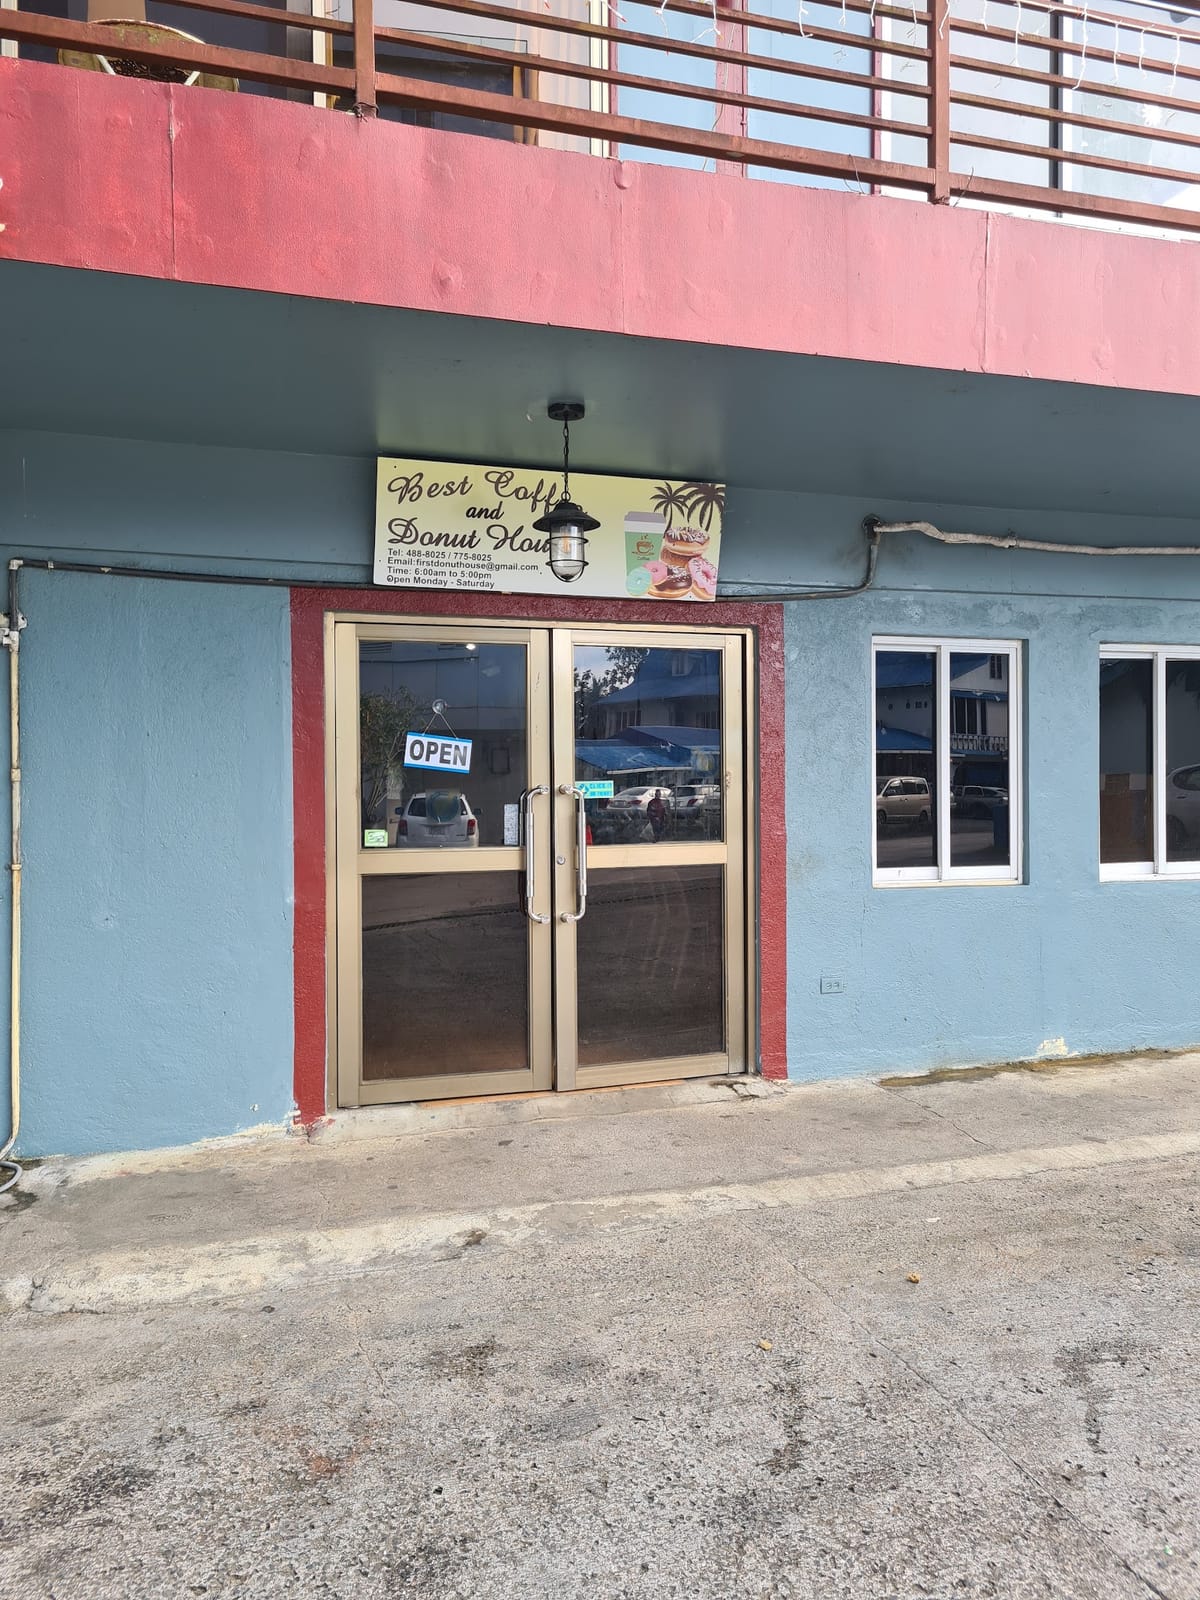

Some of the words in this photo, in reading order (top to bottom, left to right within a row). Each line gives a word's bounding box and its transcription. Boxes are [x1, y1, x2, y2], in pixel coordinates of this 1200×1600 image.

[387, 472, 473, 504] Best
[484, 470, 588, 516] Coff
[465, 501, 504, 520] and
[387, 517, 481, 549] Donut
[486, 524, 571, 553] Hou
[387, 548, 404, 557] Tel:
[406, 549, 446, 559] 488-8025
[453, 552, 492, 562] 775-8025
[386, 574, 411, 584] Open
[413, 576, 448, 587] Monday
[456, 578, 495, 589] Saturday
[387, 566, 412, 575] Time:
[414, 567, 447, 577] 6:00am
[449, 570, 458, 578] to
[460, 570, 492, 580] 5:00pm
[409, 739, 468, 767] OPEN
